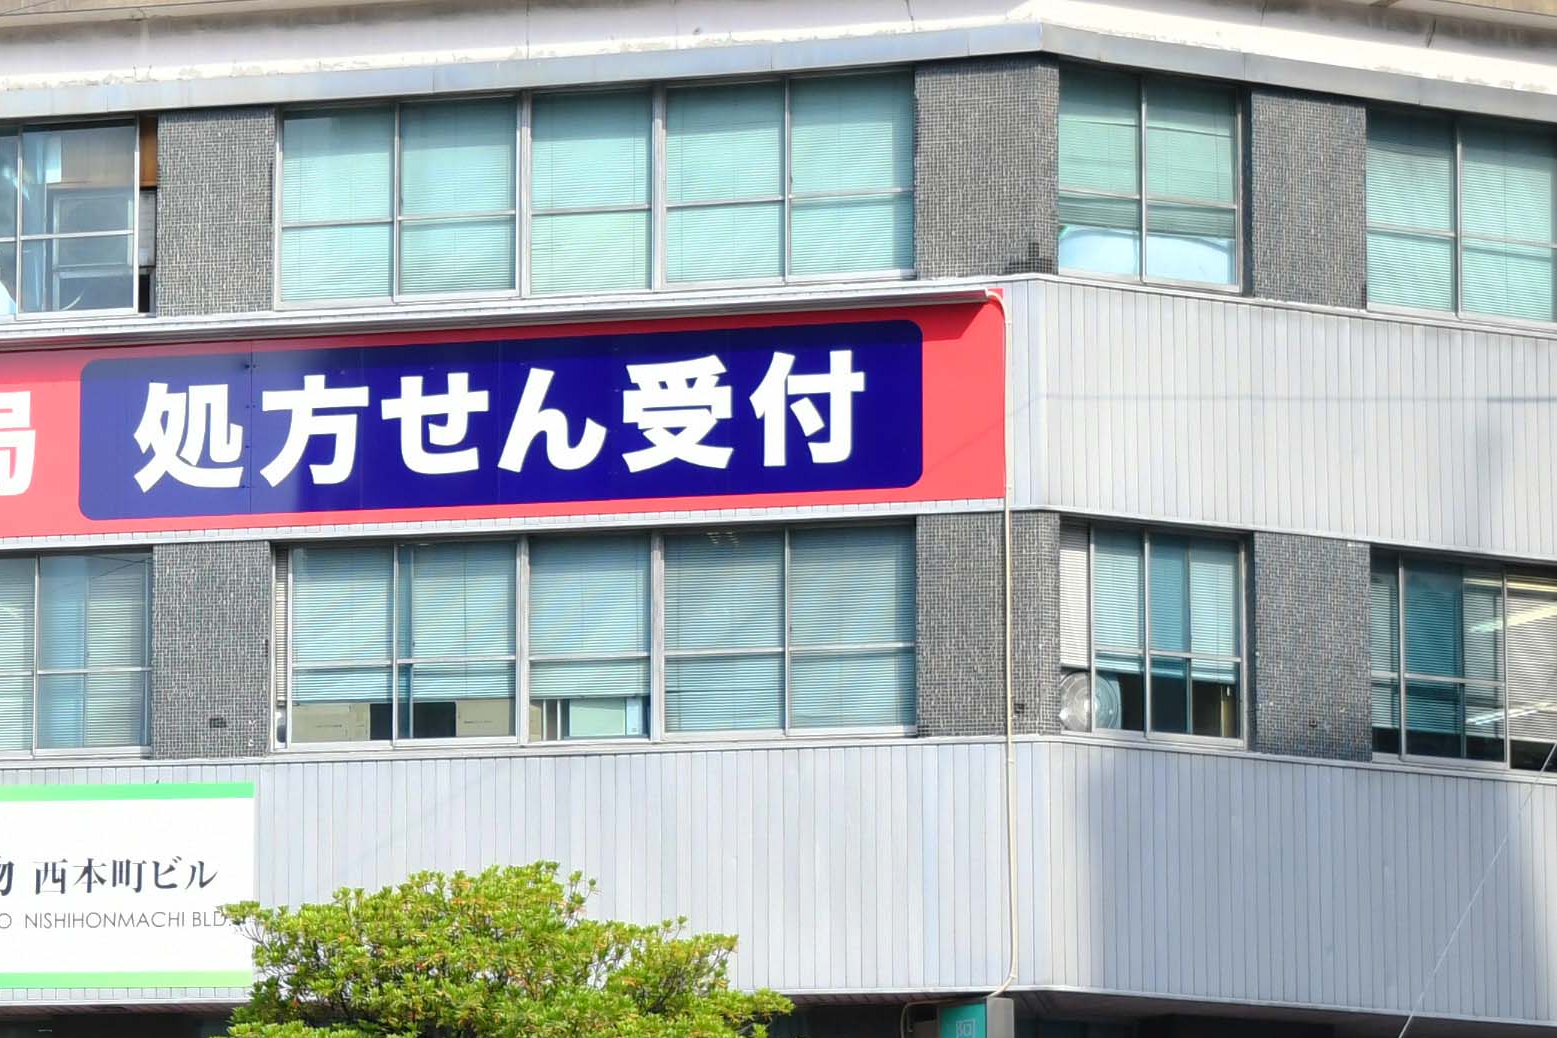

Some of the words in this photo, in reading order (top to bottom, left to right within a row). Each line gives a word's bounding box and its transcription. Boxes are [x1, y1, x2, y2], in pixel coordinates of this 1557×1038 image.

[132, 349, 866, 494] 処方せん受付
[32, 855, 219, 895] 西本町ビル
[24, 911, 186, 929] NISHIHONMACHI
